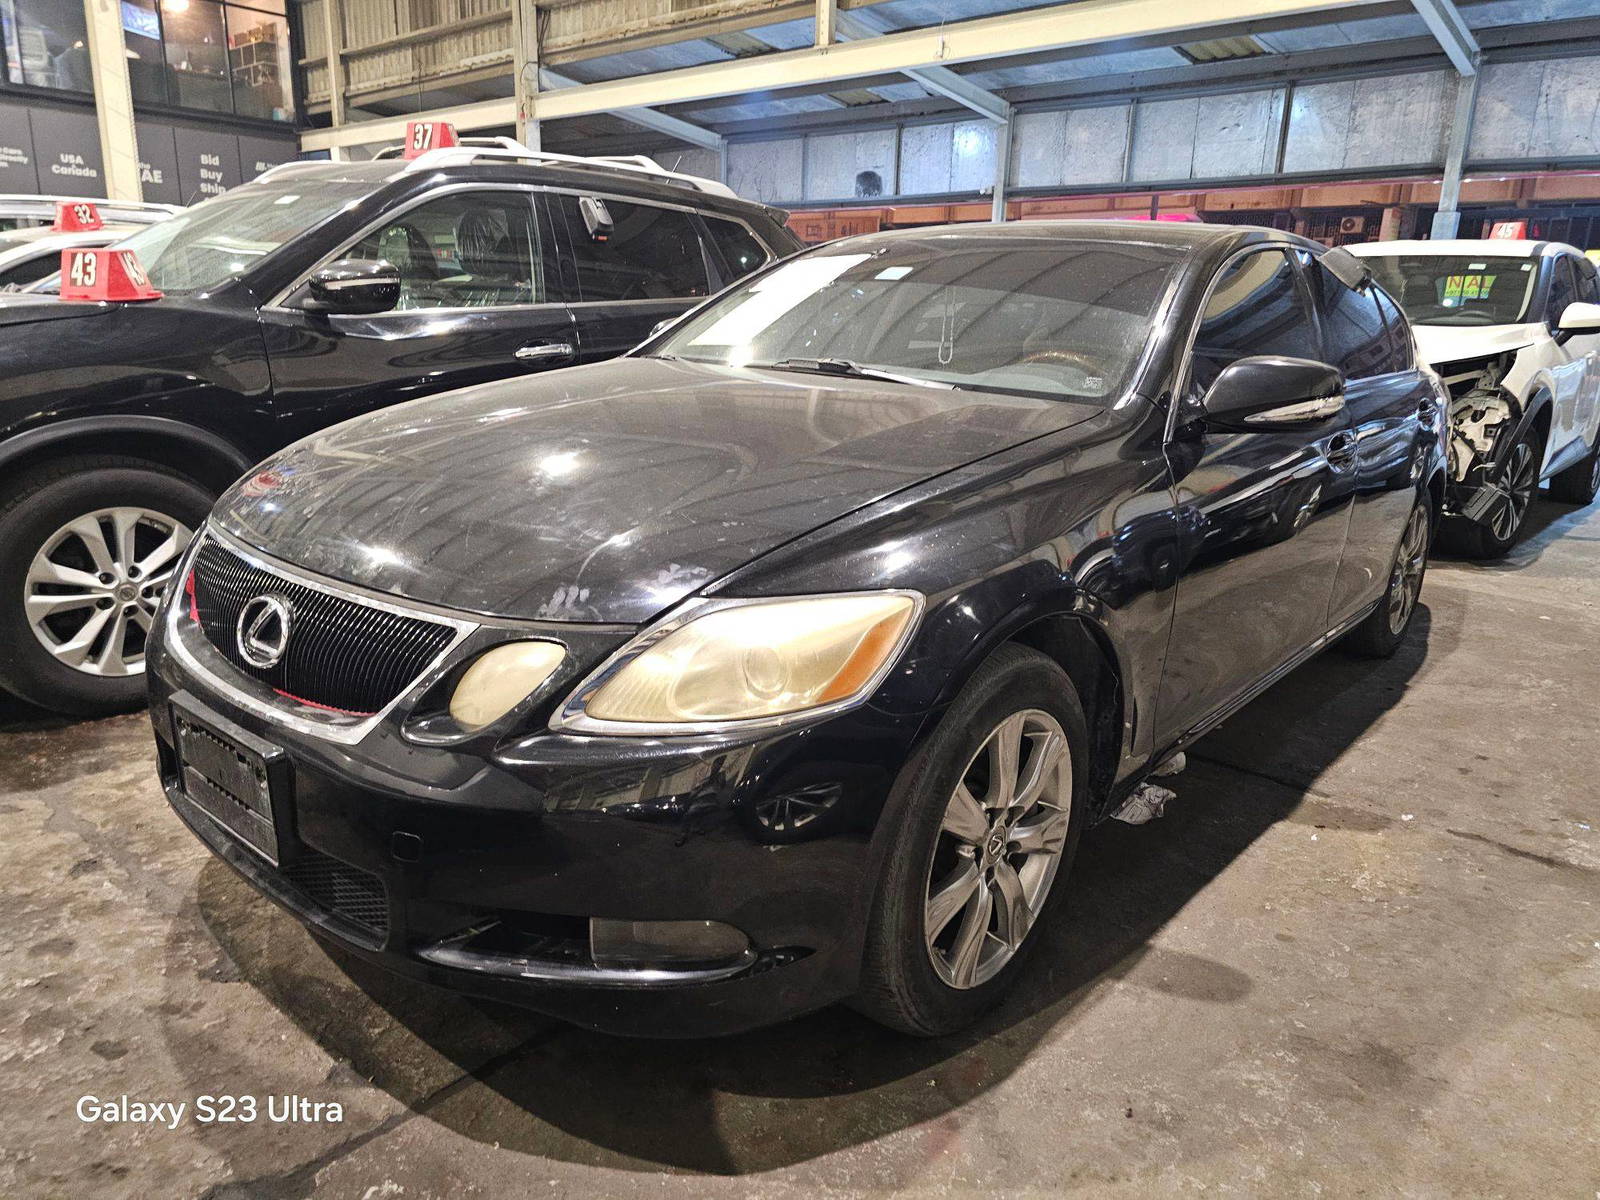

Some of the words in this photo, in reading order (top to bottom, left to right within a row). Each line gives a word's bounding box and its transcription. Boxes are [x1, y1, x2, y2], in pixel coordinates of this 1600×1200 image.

[414, 124, 433, 150] 37
[60, 153, 84, 165] USA
[200, 154, 220, 166] Bid
[51, 164, 97, 177] Canada
[141, 169, 163, 184] AE
[200, 168, 223, 183] Buy
[74, 204, 95, 224] 32
[1496, 223, 1515, 239] 45
[70, 251, 97, 287] 43
